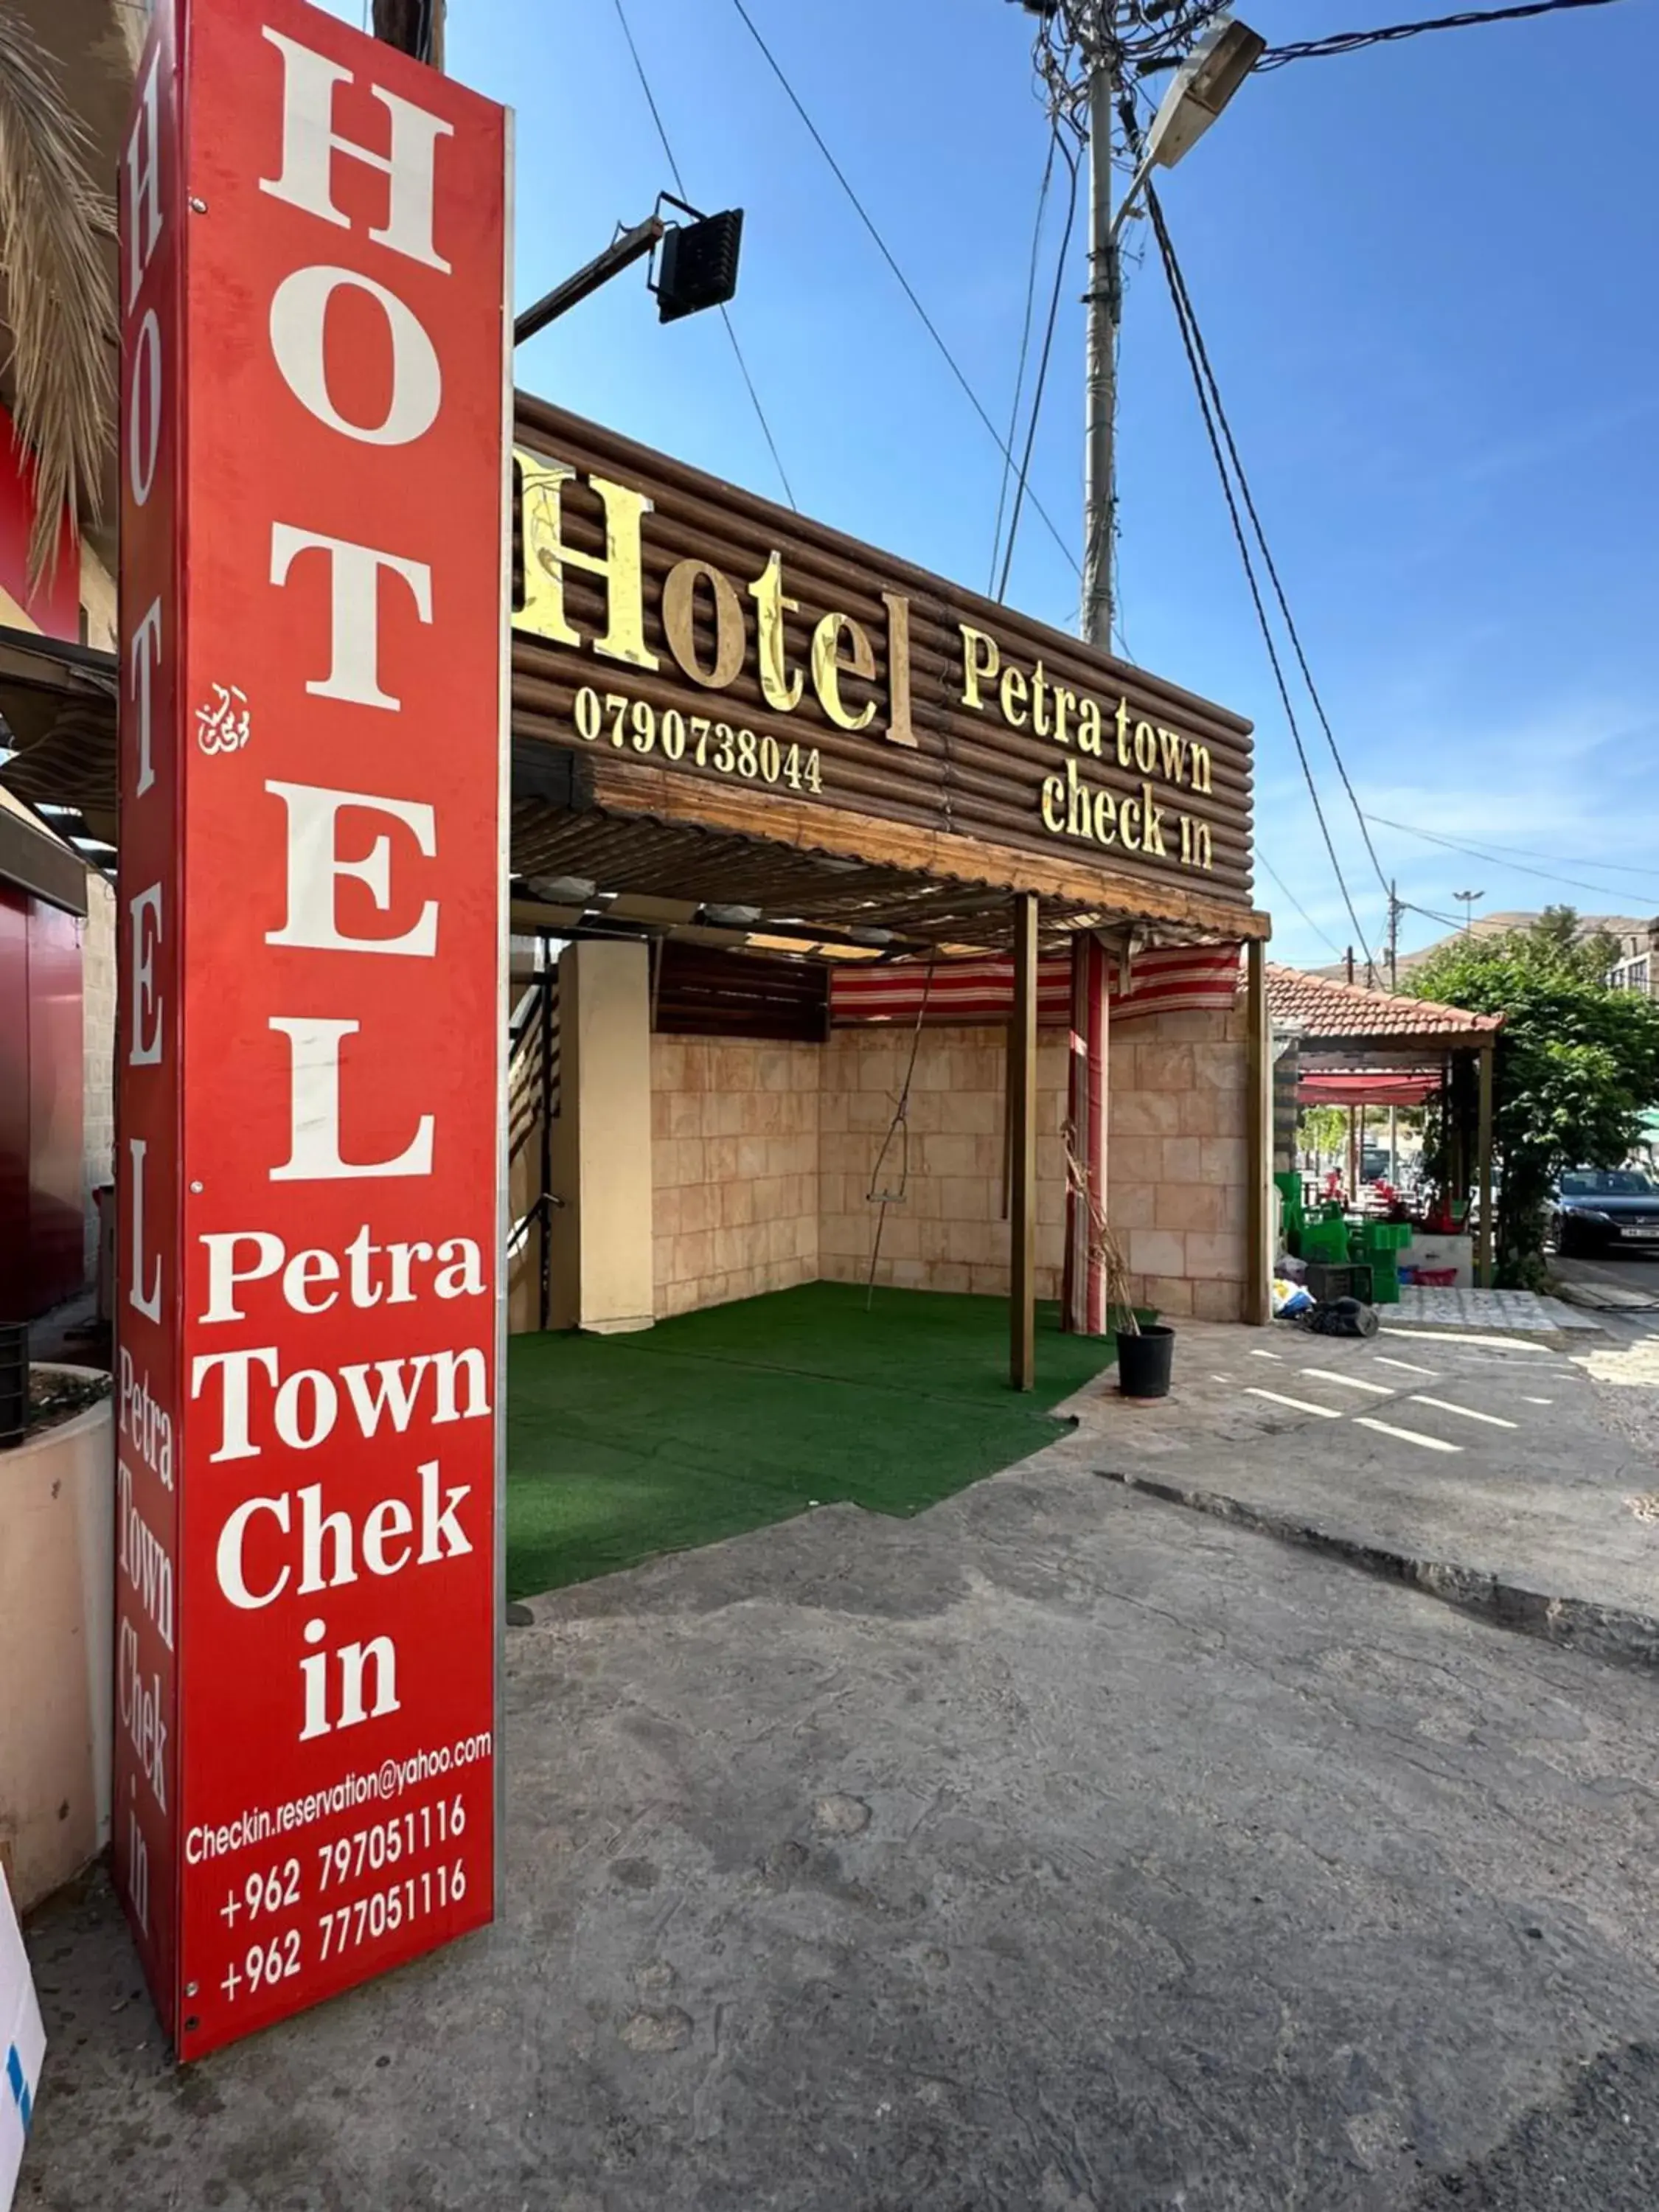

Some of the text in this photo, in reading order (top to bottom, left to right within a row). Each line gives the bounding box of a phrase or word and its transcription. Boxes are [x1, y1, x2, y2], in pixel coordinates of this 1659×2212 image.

[259, 24, 454, 1181] HOTEL
[510, 442, 918, 748] Hotel
[127, 38, 163, 1325] HOTEL
[574, 686, 823, 794] 0790738044
[959, 624, 1212, 794] Petra town
[1041, 759, 1212, 870] check in
[198, 1224, 487, 1324] Petra
[119, 1344, 174, 1492] Petra
[191, 1346, 492, 1464] Town
[118, 1458, 174, 1652] Town
[216, 1459, 473, 1610] Chek
[119, 1615, 167, 1817] Chek
[299, 1618, 401, 1742] in
[129, 1772, 149, 1941] in
[185, 1731, 492, 1865] Checkin.reservation@yahoo.com
[220, 1793, 466, 1929] +962 797051116
[220, 1858, 467, 2002] +962 777051116
